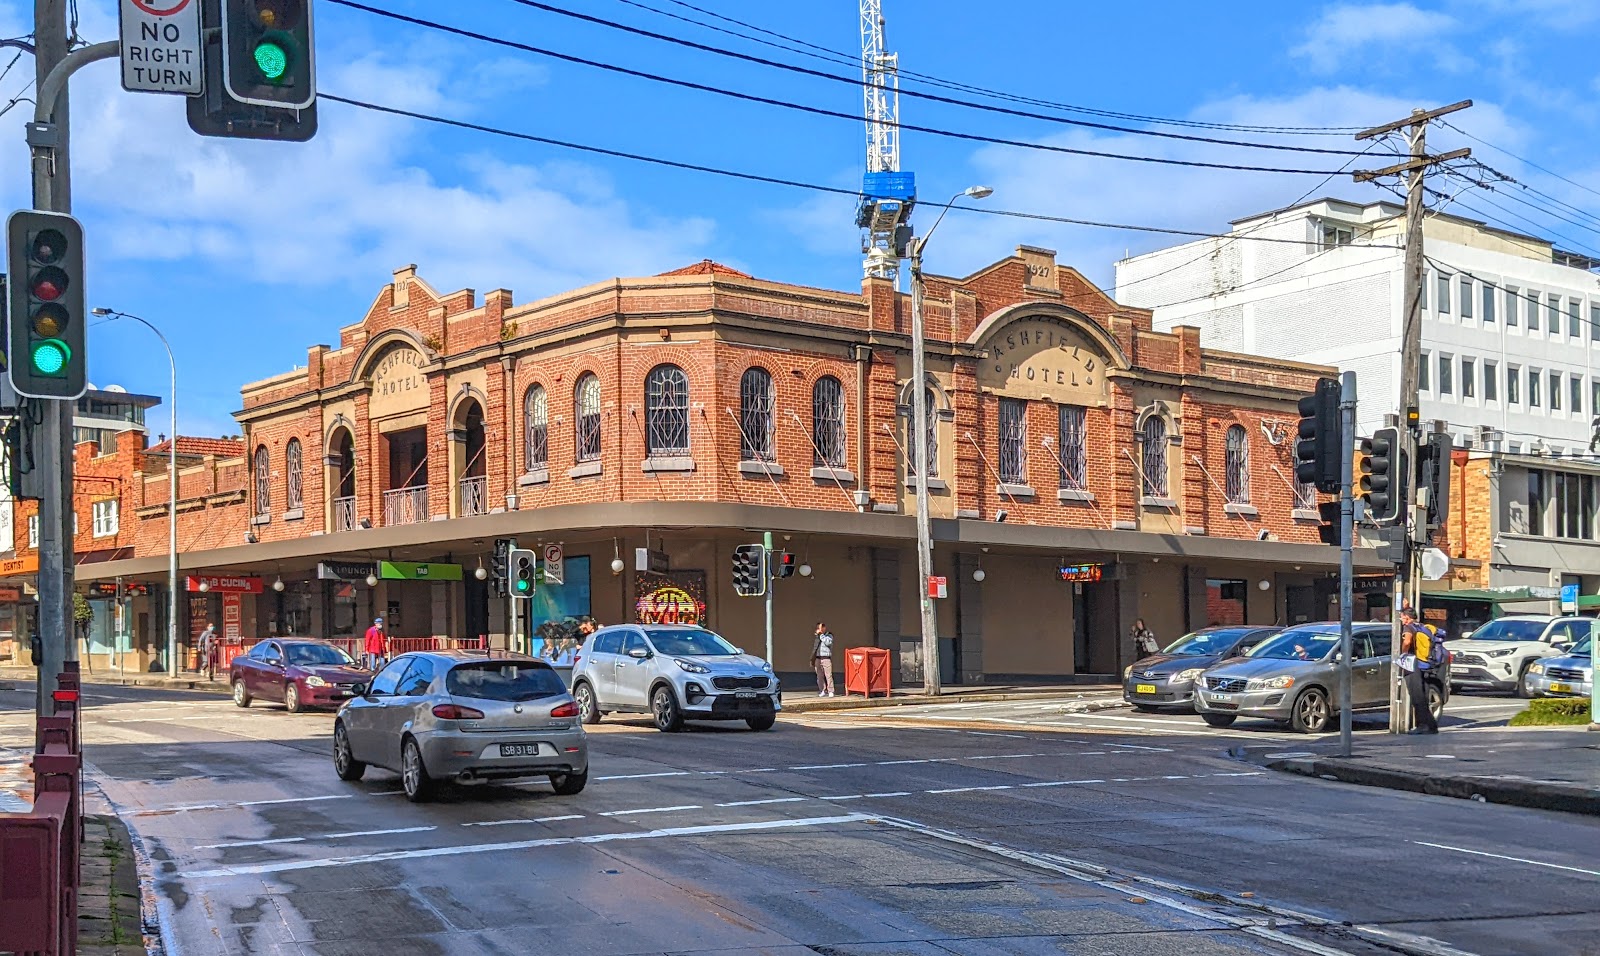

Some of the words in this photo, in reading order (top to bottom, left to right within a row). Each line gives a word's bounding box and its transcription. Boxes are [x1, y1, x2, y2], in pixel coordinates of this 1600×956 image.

[141, 21, 180, 43] NO
[130, 46, 193, 64] RIGHT
[133, 67, 192, 86] TURN
[1026, 263, 1050, 278] 1927
[993, 330, 1095, 372] ASHFIELD
[377, 350, 424, 383] ASHFIELD
[1010, 363, 1079, 386] HOTEL
[383, 375, 419, 396] HOTEL
[4, 561, 24, 572] DENTIST
[416, 567, 428, 575] TAB
[221, 578, 251, 590] CUCINA
